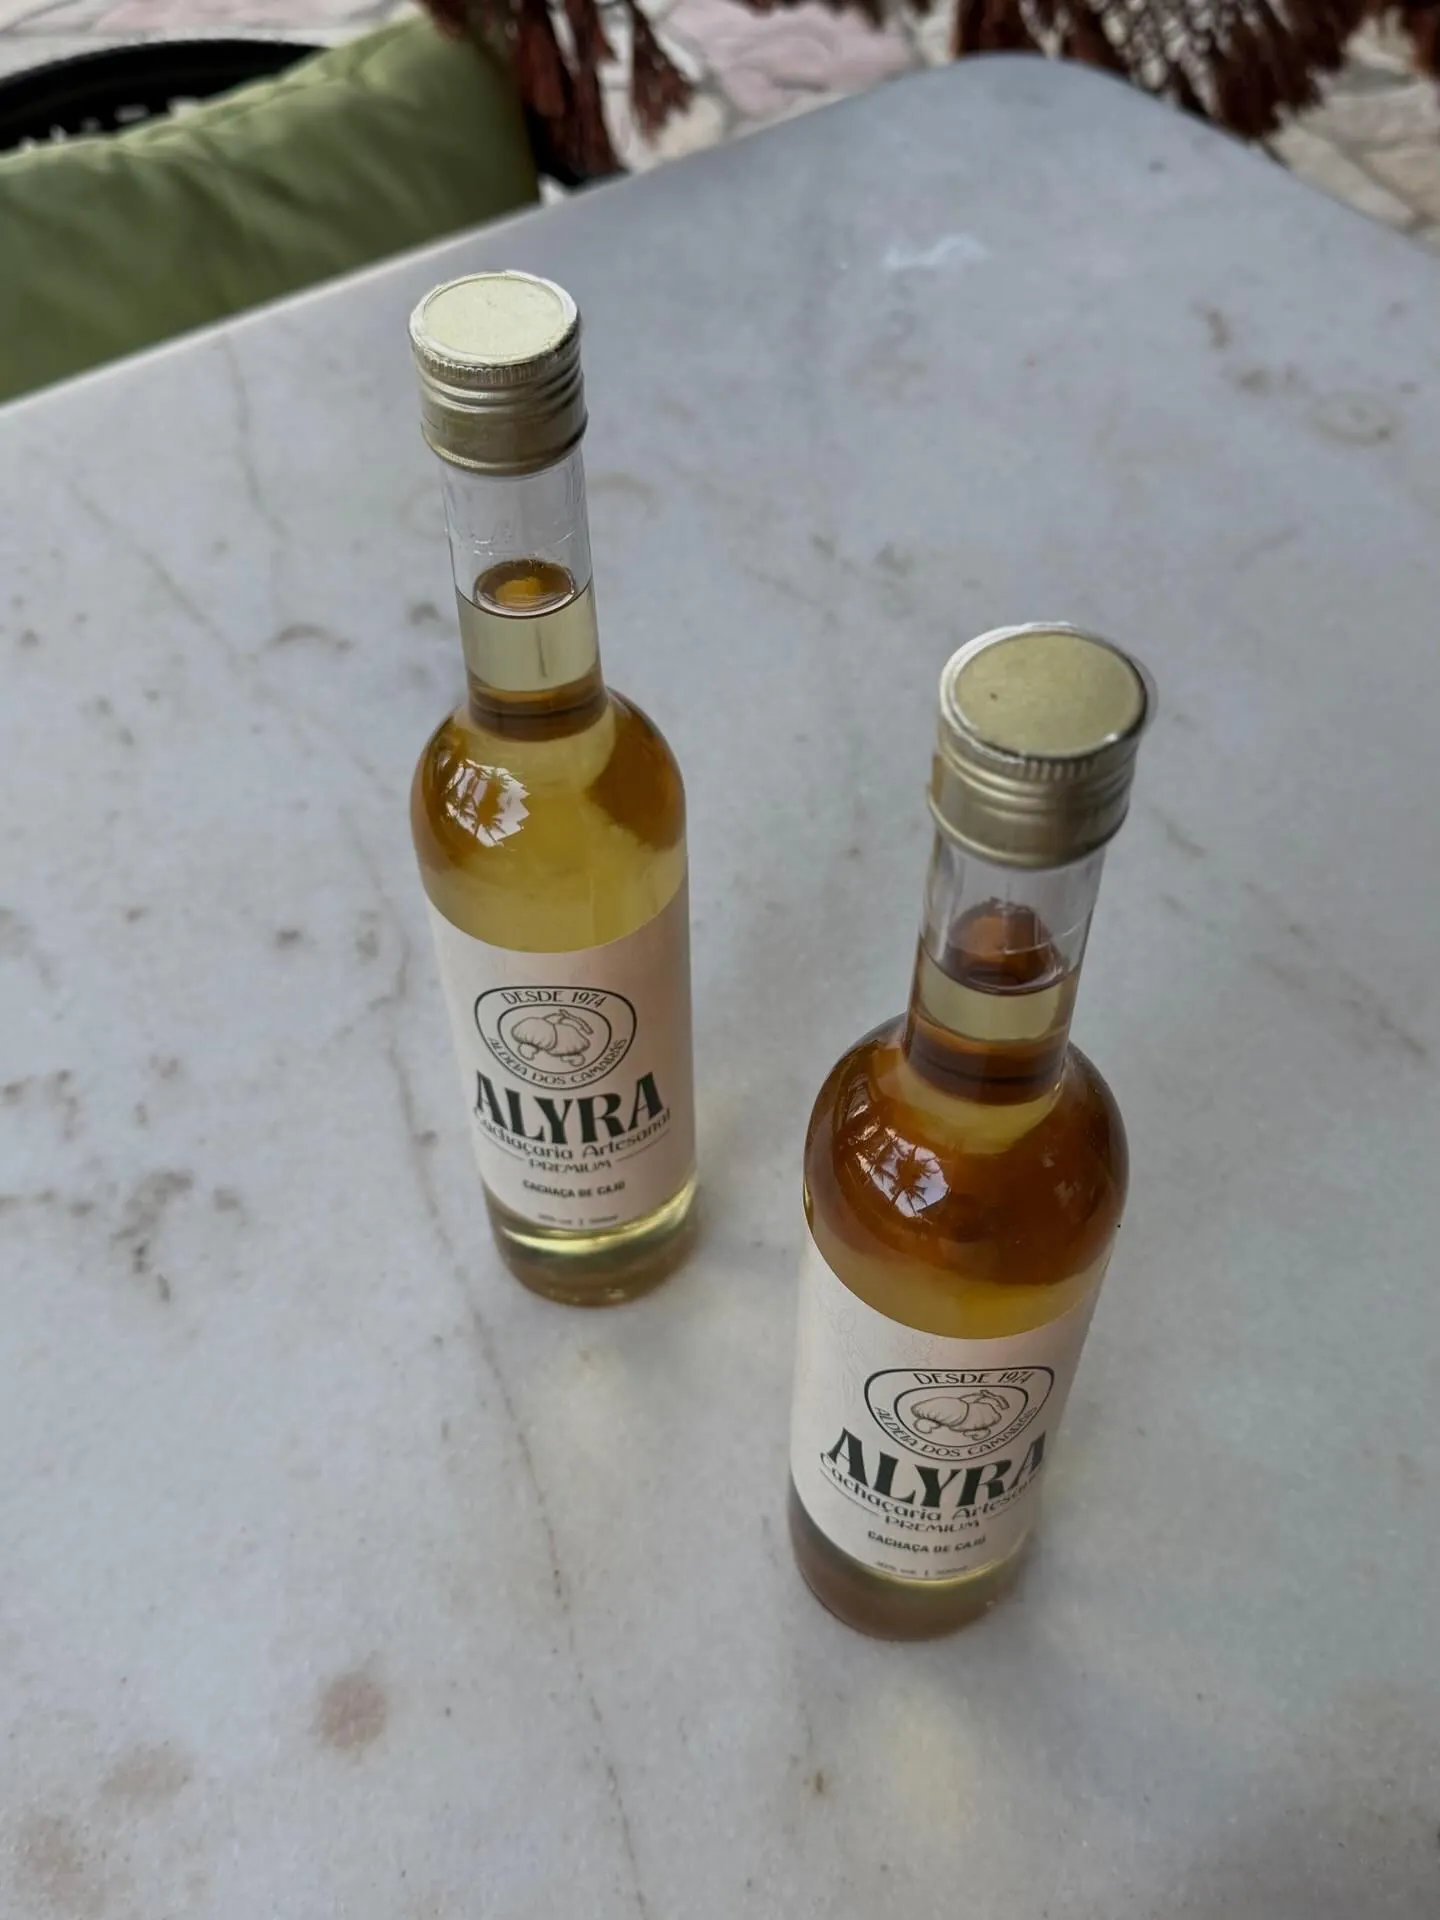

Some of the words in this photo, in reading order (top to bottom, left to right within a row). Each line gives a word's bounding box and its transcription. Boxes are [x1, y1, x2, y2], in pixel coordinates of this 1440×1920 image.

[501, 990, 564, 1005] DESDE
[571, 991, 607, 1008] 1974
[532, 1072, 566, 1085] DOS
[476, 1070, 664, 1145] ALYRA
[474, 1105, 574, 1160] Cachaçaria
[583, 1107, 671, 1159] Artesanal
[529, 1158, 612, 1174] PREMIUM
[578, 1184, 593, 1197] DE
[912, 1372, 990, 1385] DESDE
[997, 1371, 1036, 1385] 1974
[874, 1406, 918, 1447] ALDEIA
[921, 1444, 961, 1457] DOS
[828, 1427, 1047, 1508] ALYRA
[820, 1452, 942, 1521] Cachaçaria
[884, 1514, 980, 1533] PREMIUM
[867, 1530, 930, 1553] CACHAÇA
[933, 1544, 952, 1553] DE
